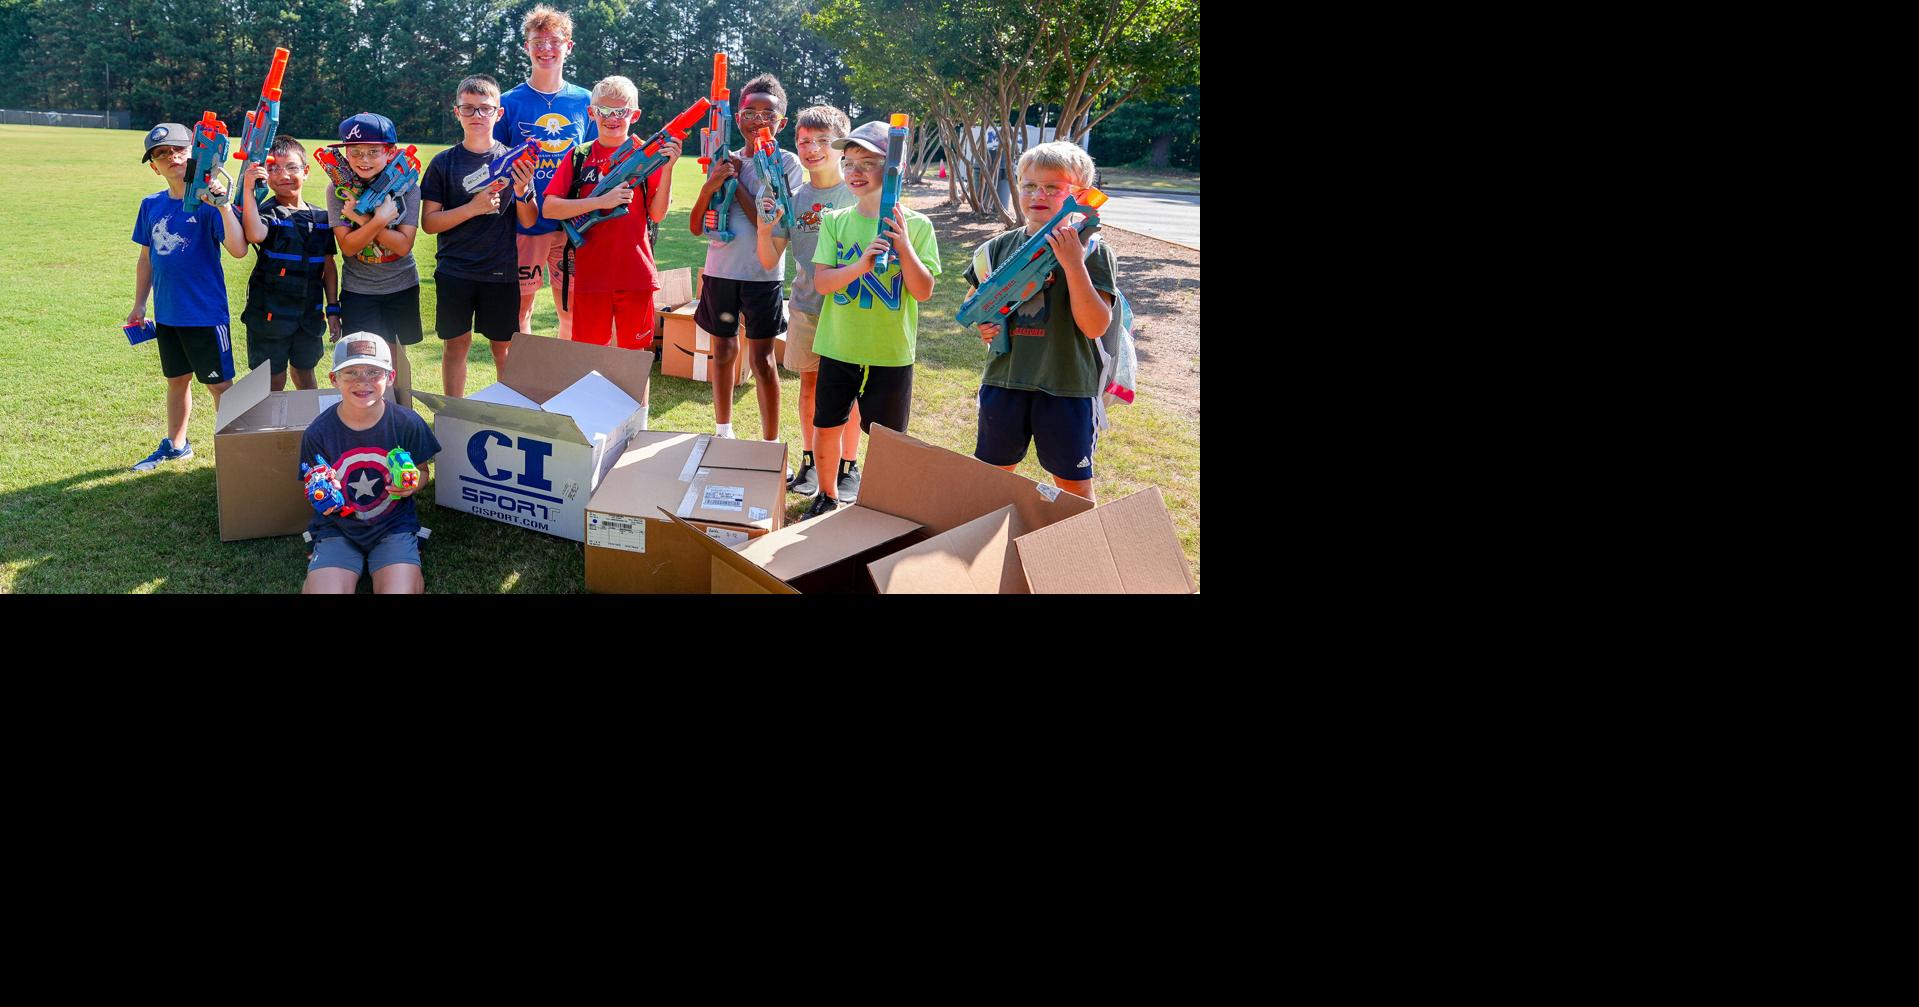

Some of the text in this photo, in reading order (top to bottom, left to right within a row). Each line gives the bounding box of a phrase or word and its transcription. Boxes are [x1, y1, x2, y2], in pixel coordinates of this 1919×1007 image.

[519, 265, 542, 280] SA
[467, 430, 552, 492] CI
[462, 486, 560, 522] SPORT
[472, 505, 549, 531] CISPORT.COM
